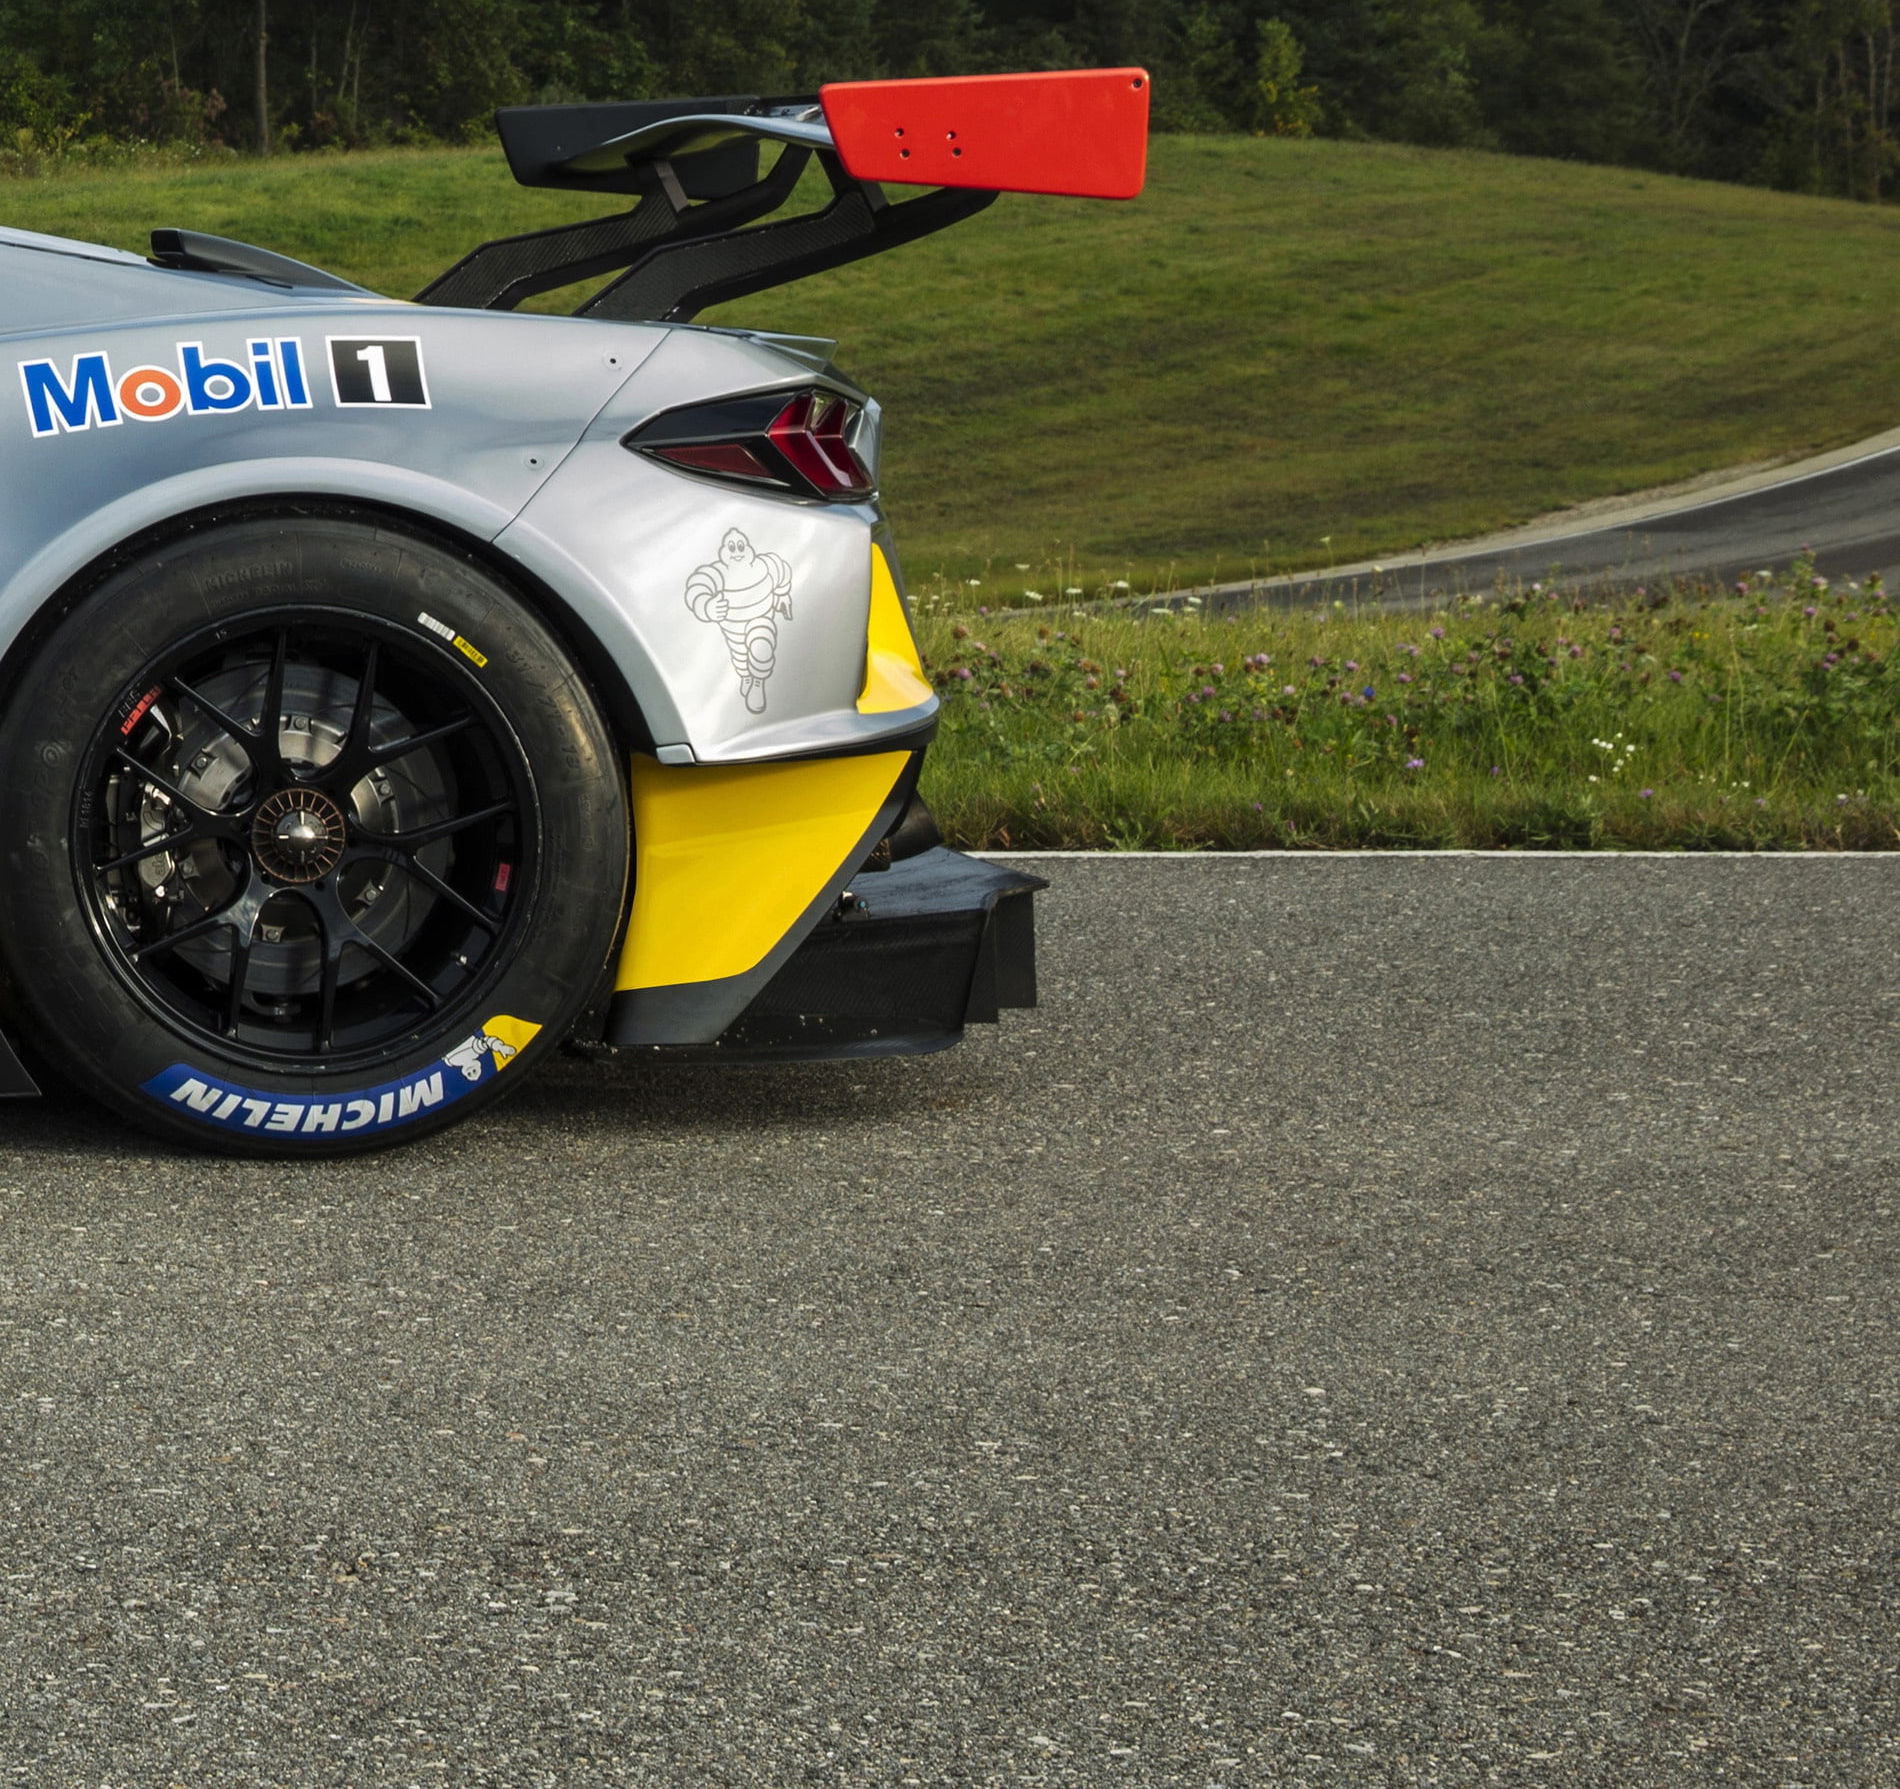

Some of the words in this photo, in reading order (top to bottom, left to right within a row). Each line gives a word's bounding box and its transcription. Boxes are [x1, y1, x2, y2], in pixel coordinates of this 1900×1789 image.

[21, 340, 310, 435] Mobil
[356, 344, 392, 402] 1
[170, 1071, 444, 1132] MICHELIN
